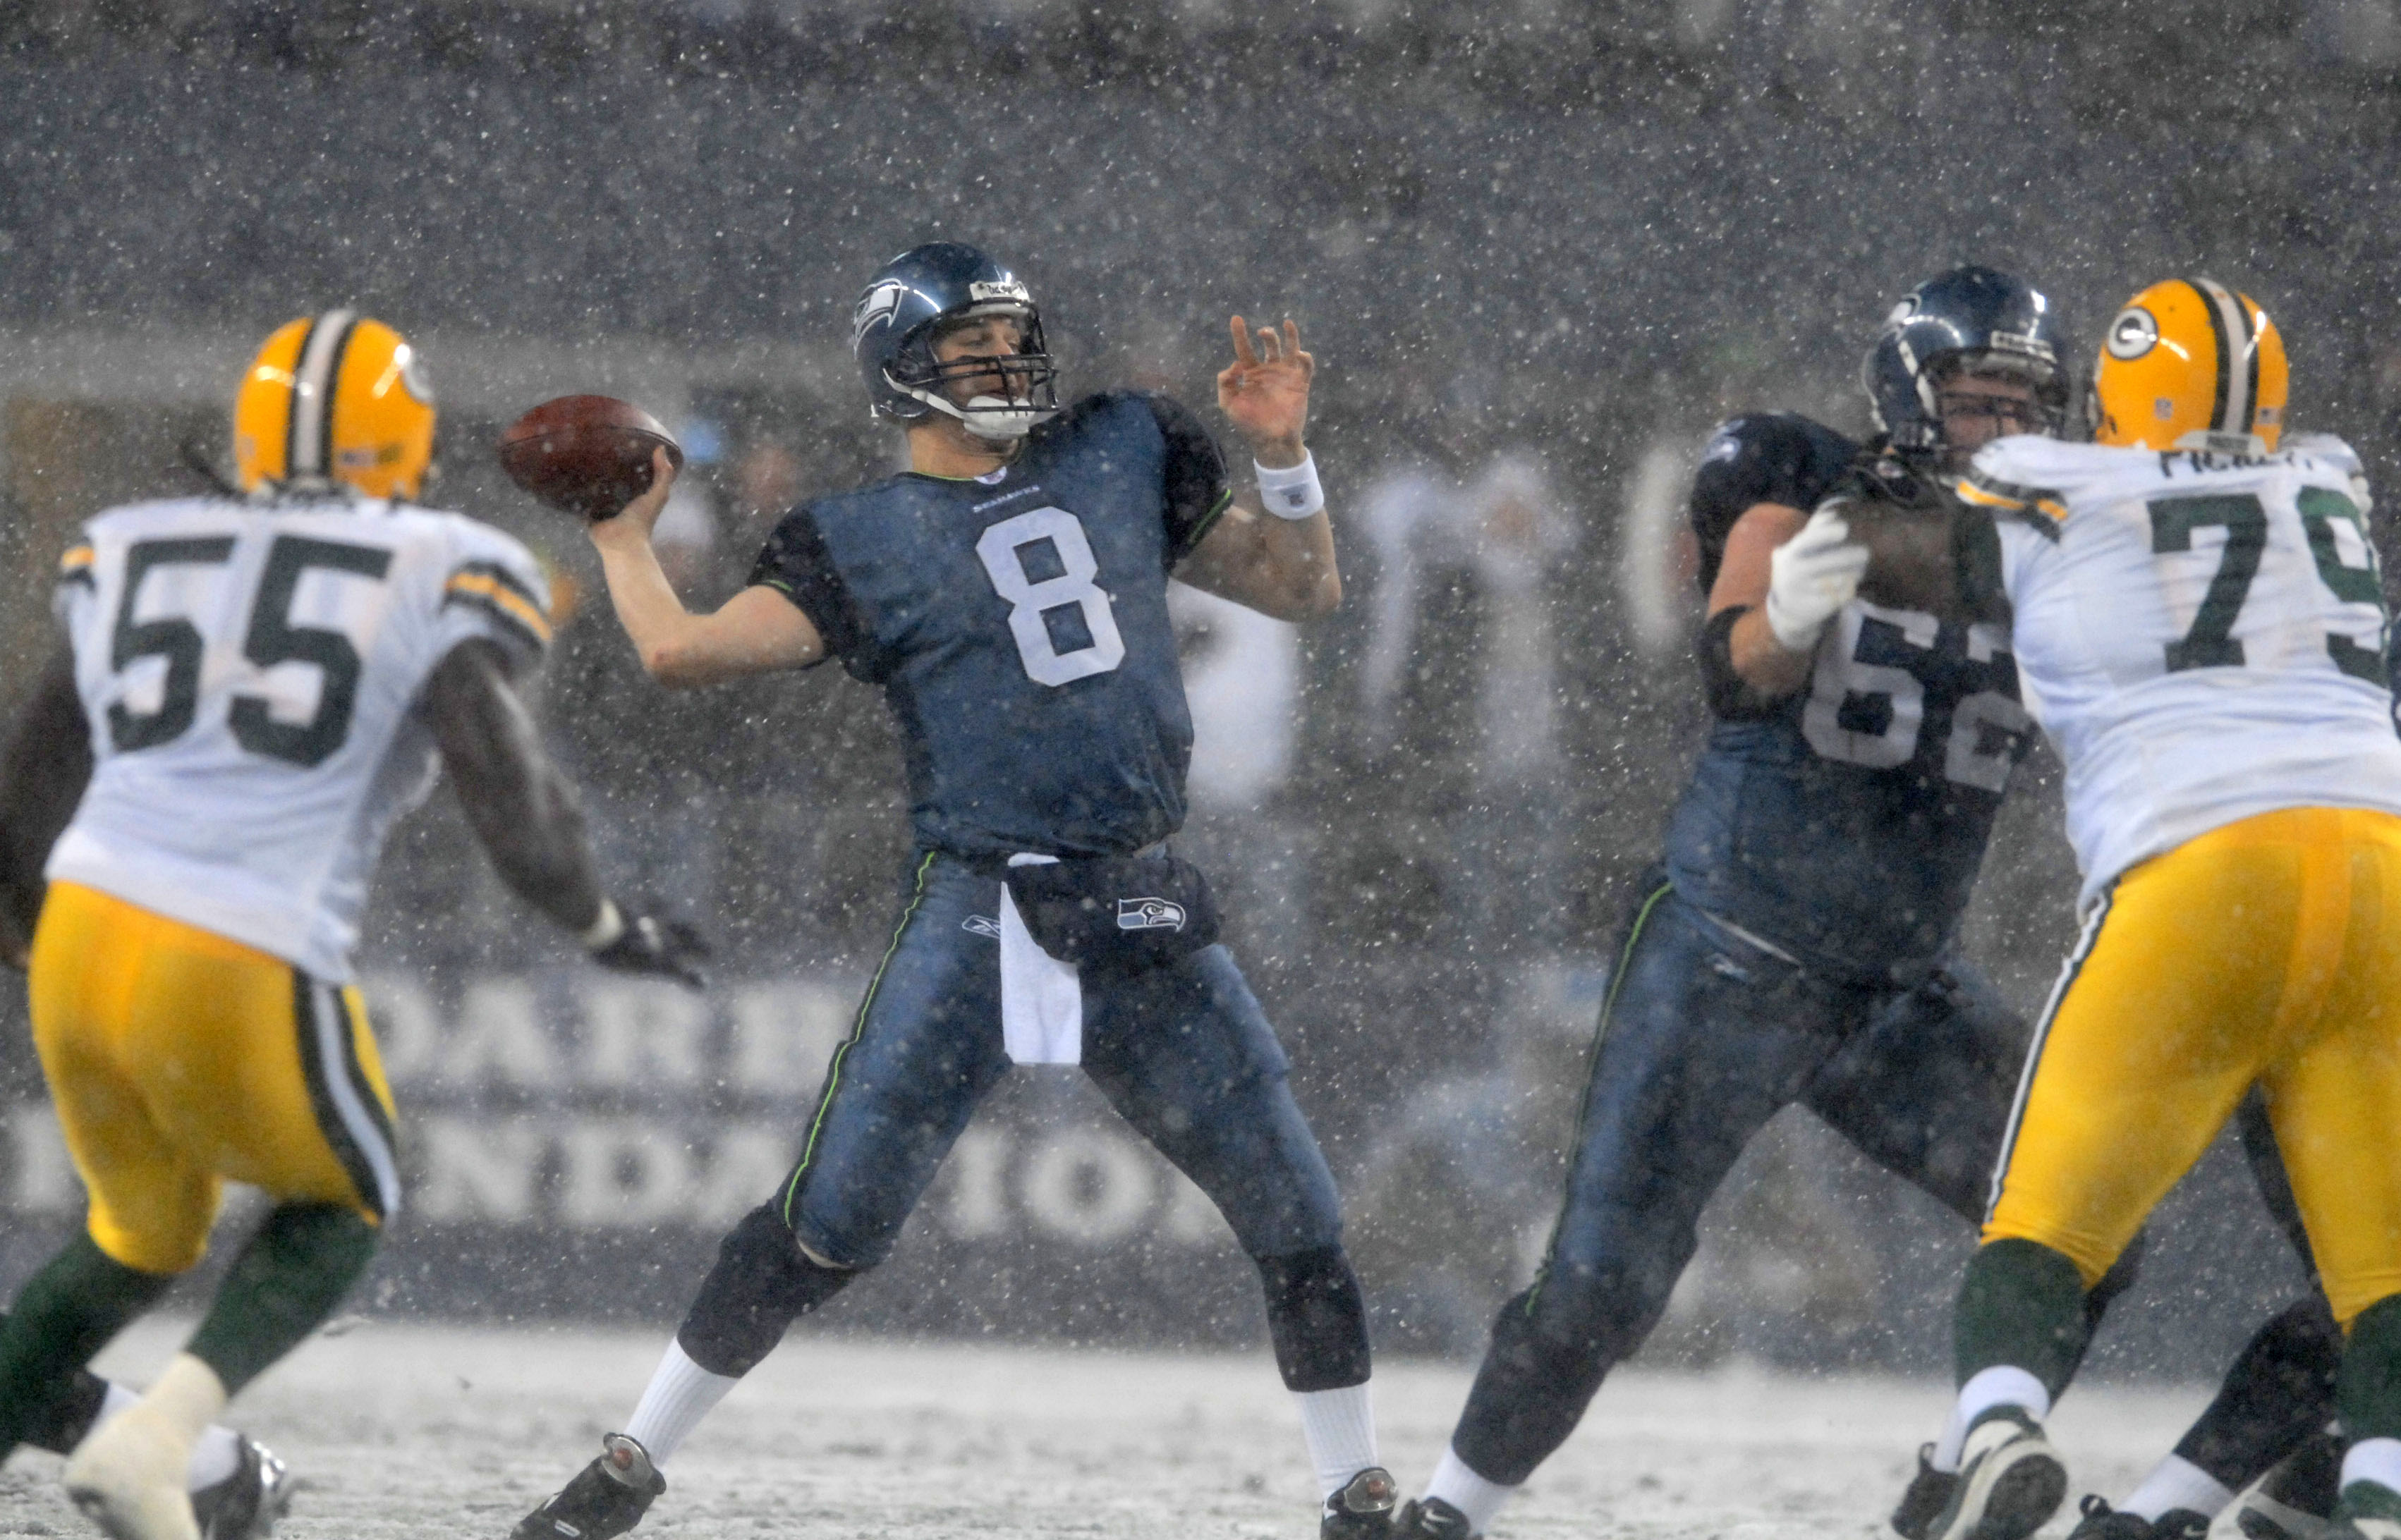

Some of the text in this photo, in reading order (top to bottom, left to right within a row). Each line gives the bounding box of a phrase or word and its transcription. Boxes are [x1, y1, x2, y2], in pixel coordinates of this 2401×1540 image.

[108, 534, 394, 768] 55
[975, 506, 1126, 687] 8
[2146, 484, 2389, 691] 79
[1801, 599, 2033, 793] 62
